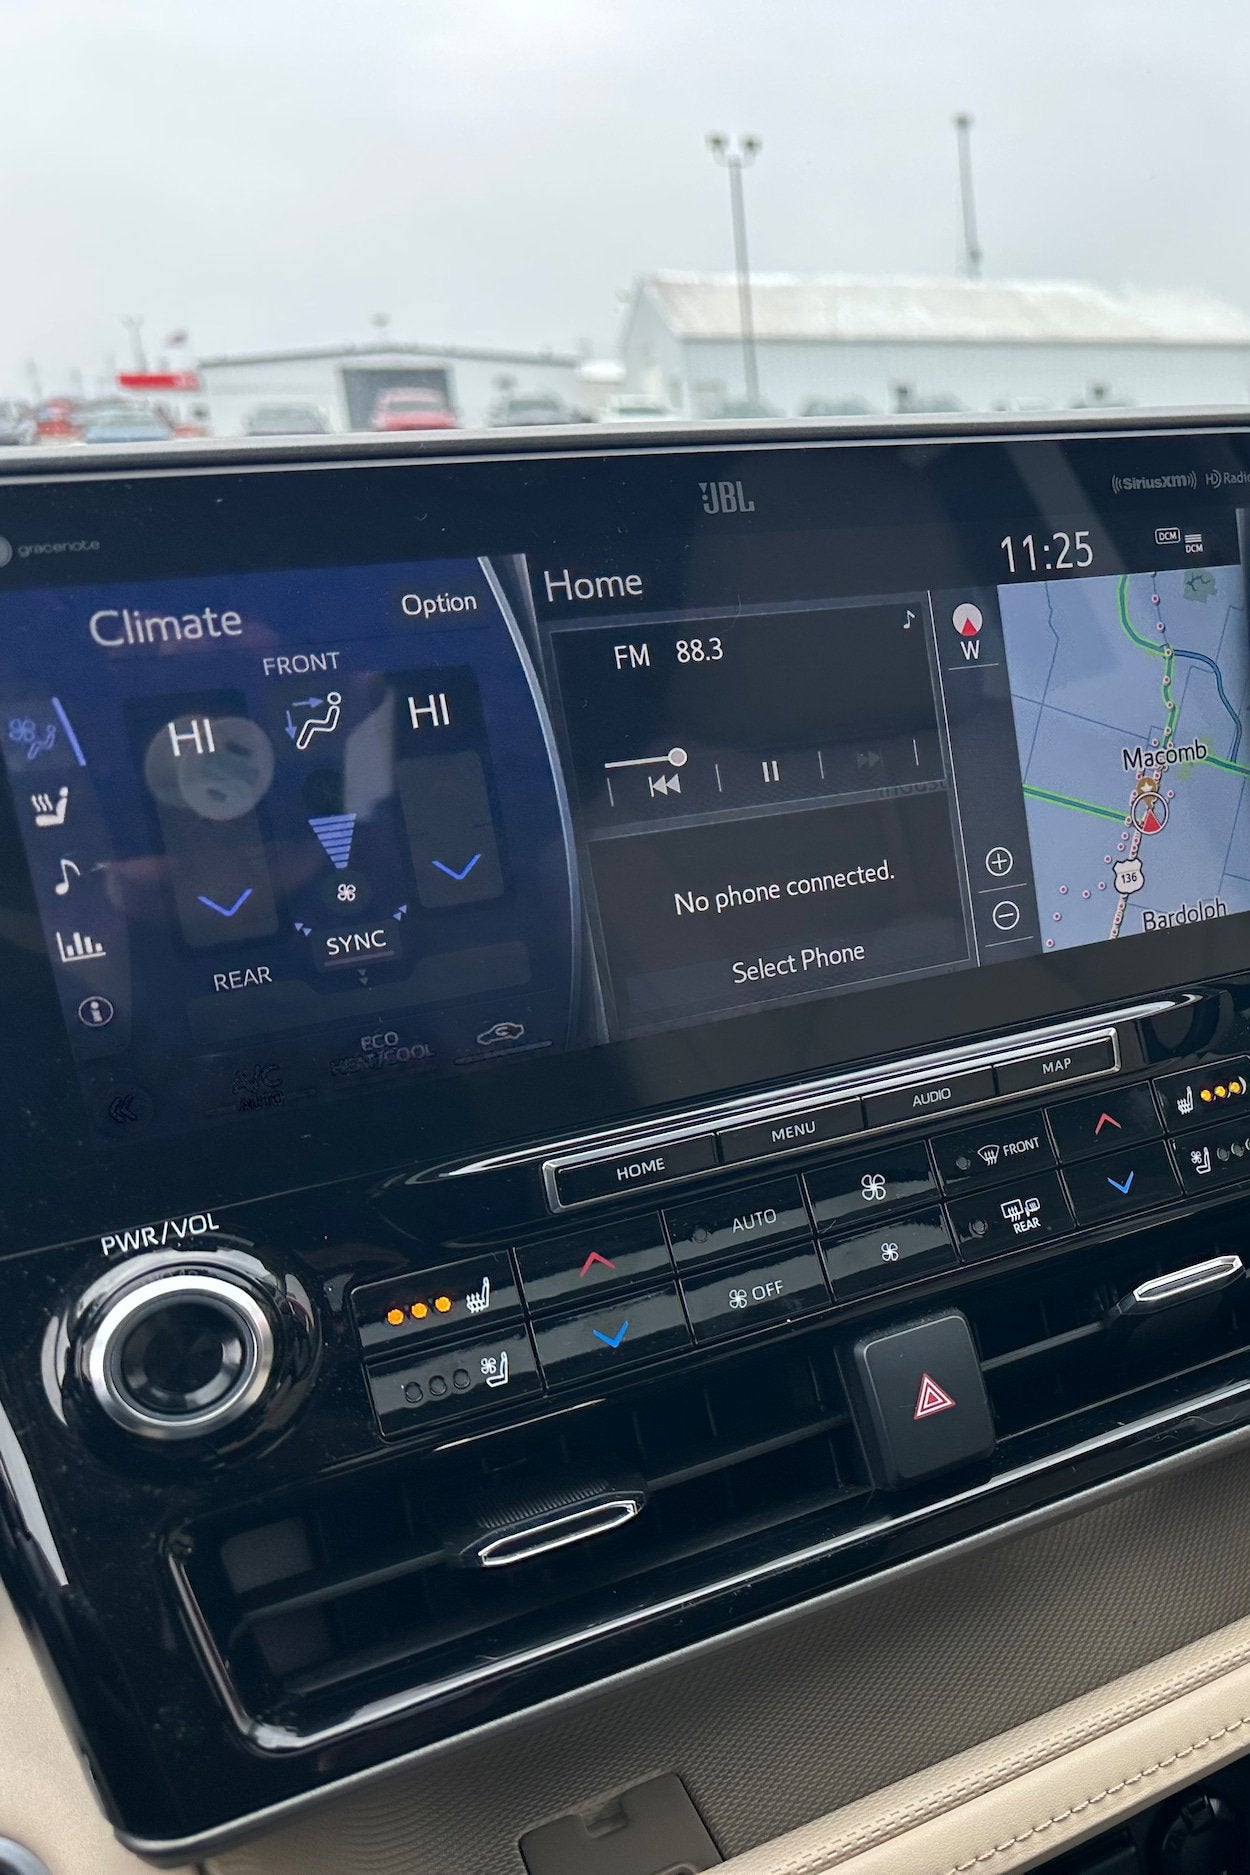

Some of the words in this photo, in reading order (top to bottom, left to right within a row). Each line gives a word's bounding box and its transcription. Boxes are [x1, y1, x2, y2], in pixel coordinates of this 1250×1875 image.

[699, 480, 755, 514] JBL
[1158, 531, 1178, 541] DCM
[1185, 544, 1203, 553] DCM
[1001, 530, 1094, 573] 11:25
[544, 569, 643, 602] Home
[402, 592, 477, 619] Option
[89, 607, 243, 647] Climate
[614, 644, 650, 669] FM
[675, 637, 724, 664] 88.3
[960, 640, 980, 660] W
[262, 651, 340, 677] FRONT
[408, 693, 450, 729] HI
[168, 718, 215, 757] HI
[1122, 740, 1208, 773] Macomb
[674, 892, 709, 916] No
[715, 883, 781, 914] phone
[786, 860, 895, 897] connected.
[1121, 872, 1138, 884] 136
[1143, 897, 1227, 932] Bardolph
[326, 929, 387, 956] SYNC
[732, 956, 797, 984] Select
[801, 943, 865, 971] Phone
[213, 965, 272, 992] REAR
[361, 1031, 399, 1051] ECO
[1042, 1057, 1072, 1075] MAP
[912, 1087, 952, 1107] AUDIO
[771, 1121, 817, 1142] MENU
[1002, 1136, 1040, 1159] FRONT
[616, 1157, 665, 1182] HOME
[100, 1212, 220, 1256] PWR/VOL
[732, 1208, 778, 1233] AUTO
[1013, 1216, 1041, 1234] REAR
[752, 1280, 784, 1302] OFF
